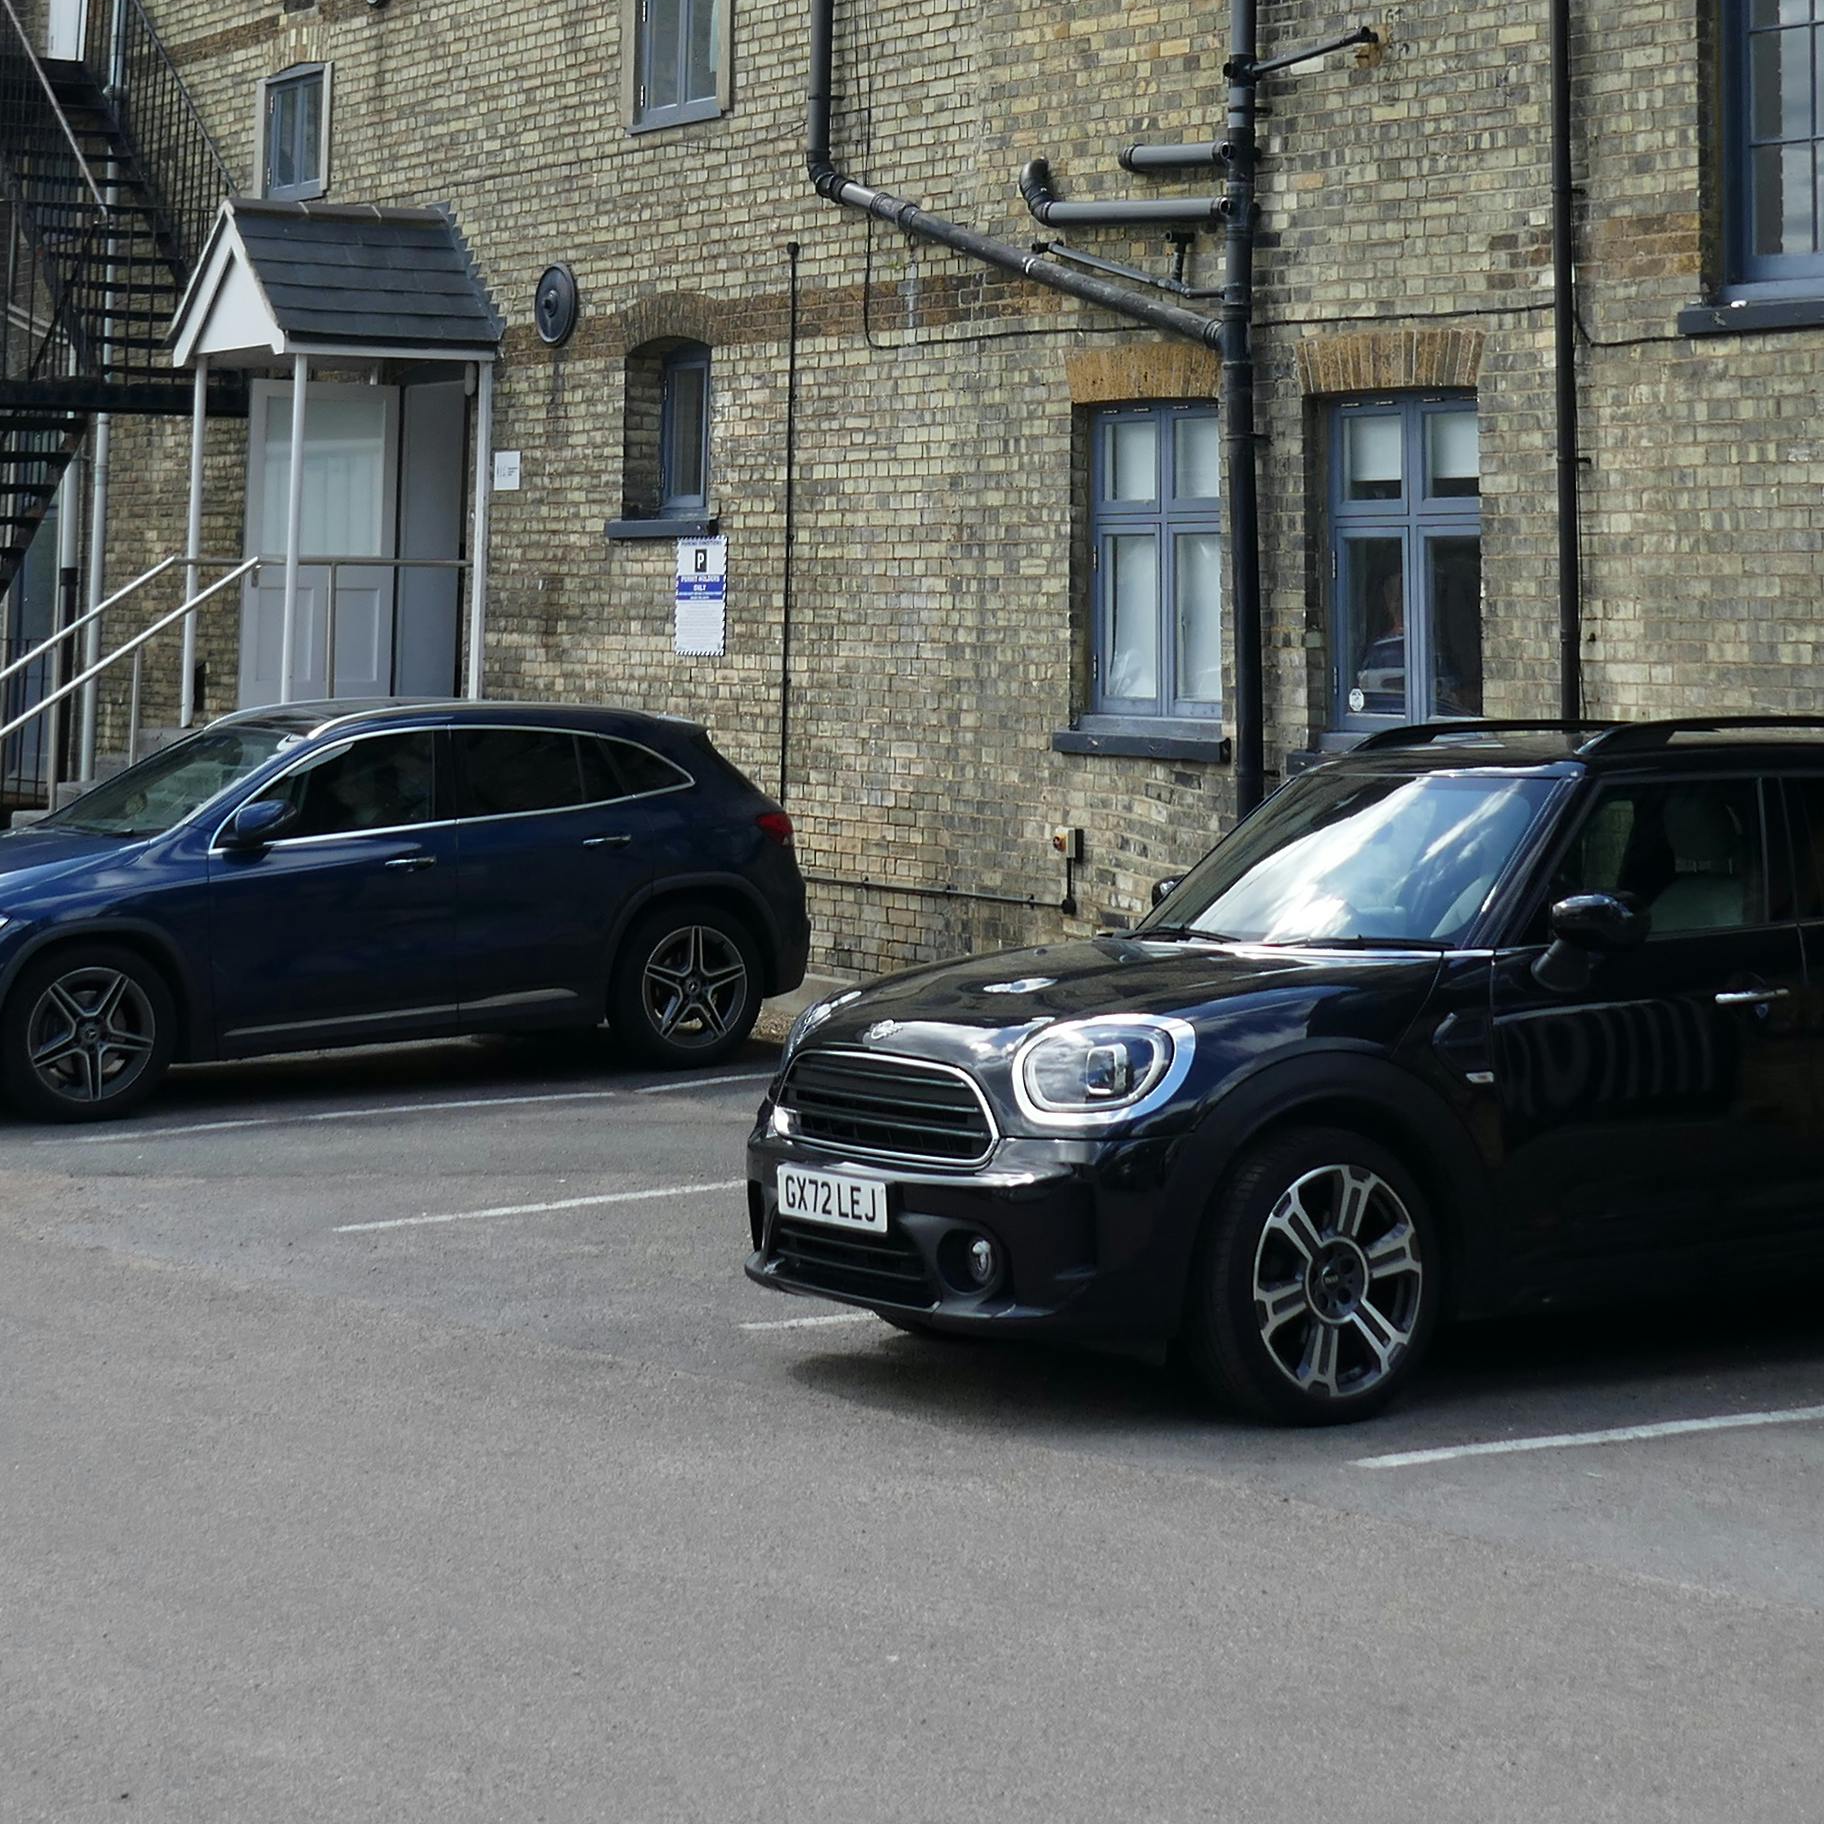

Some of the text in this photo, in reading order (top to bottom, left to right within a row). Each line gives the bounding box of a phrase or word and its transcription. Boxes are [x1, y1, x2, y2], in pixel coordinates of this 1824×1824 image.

[696, 552, 705, 570] P
[785, 1174, 876, 1223] GX72 LEJ
